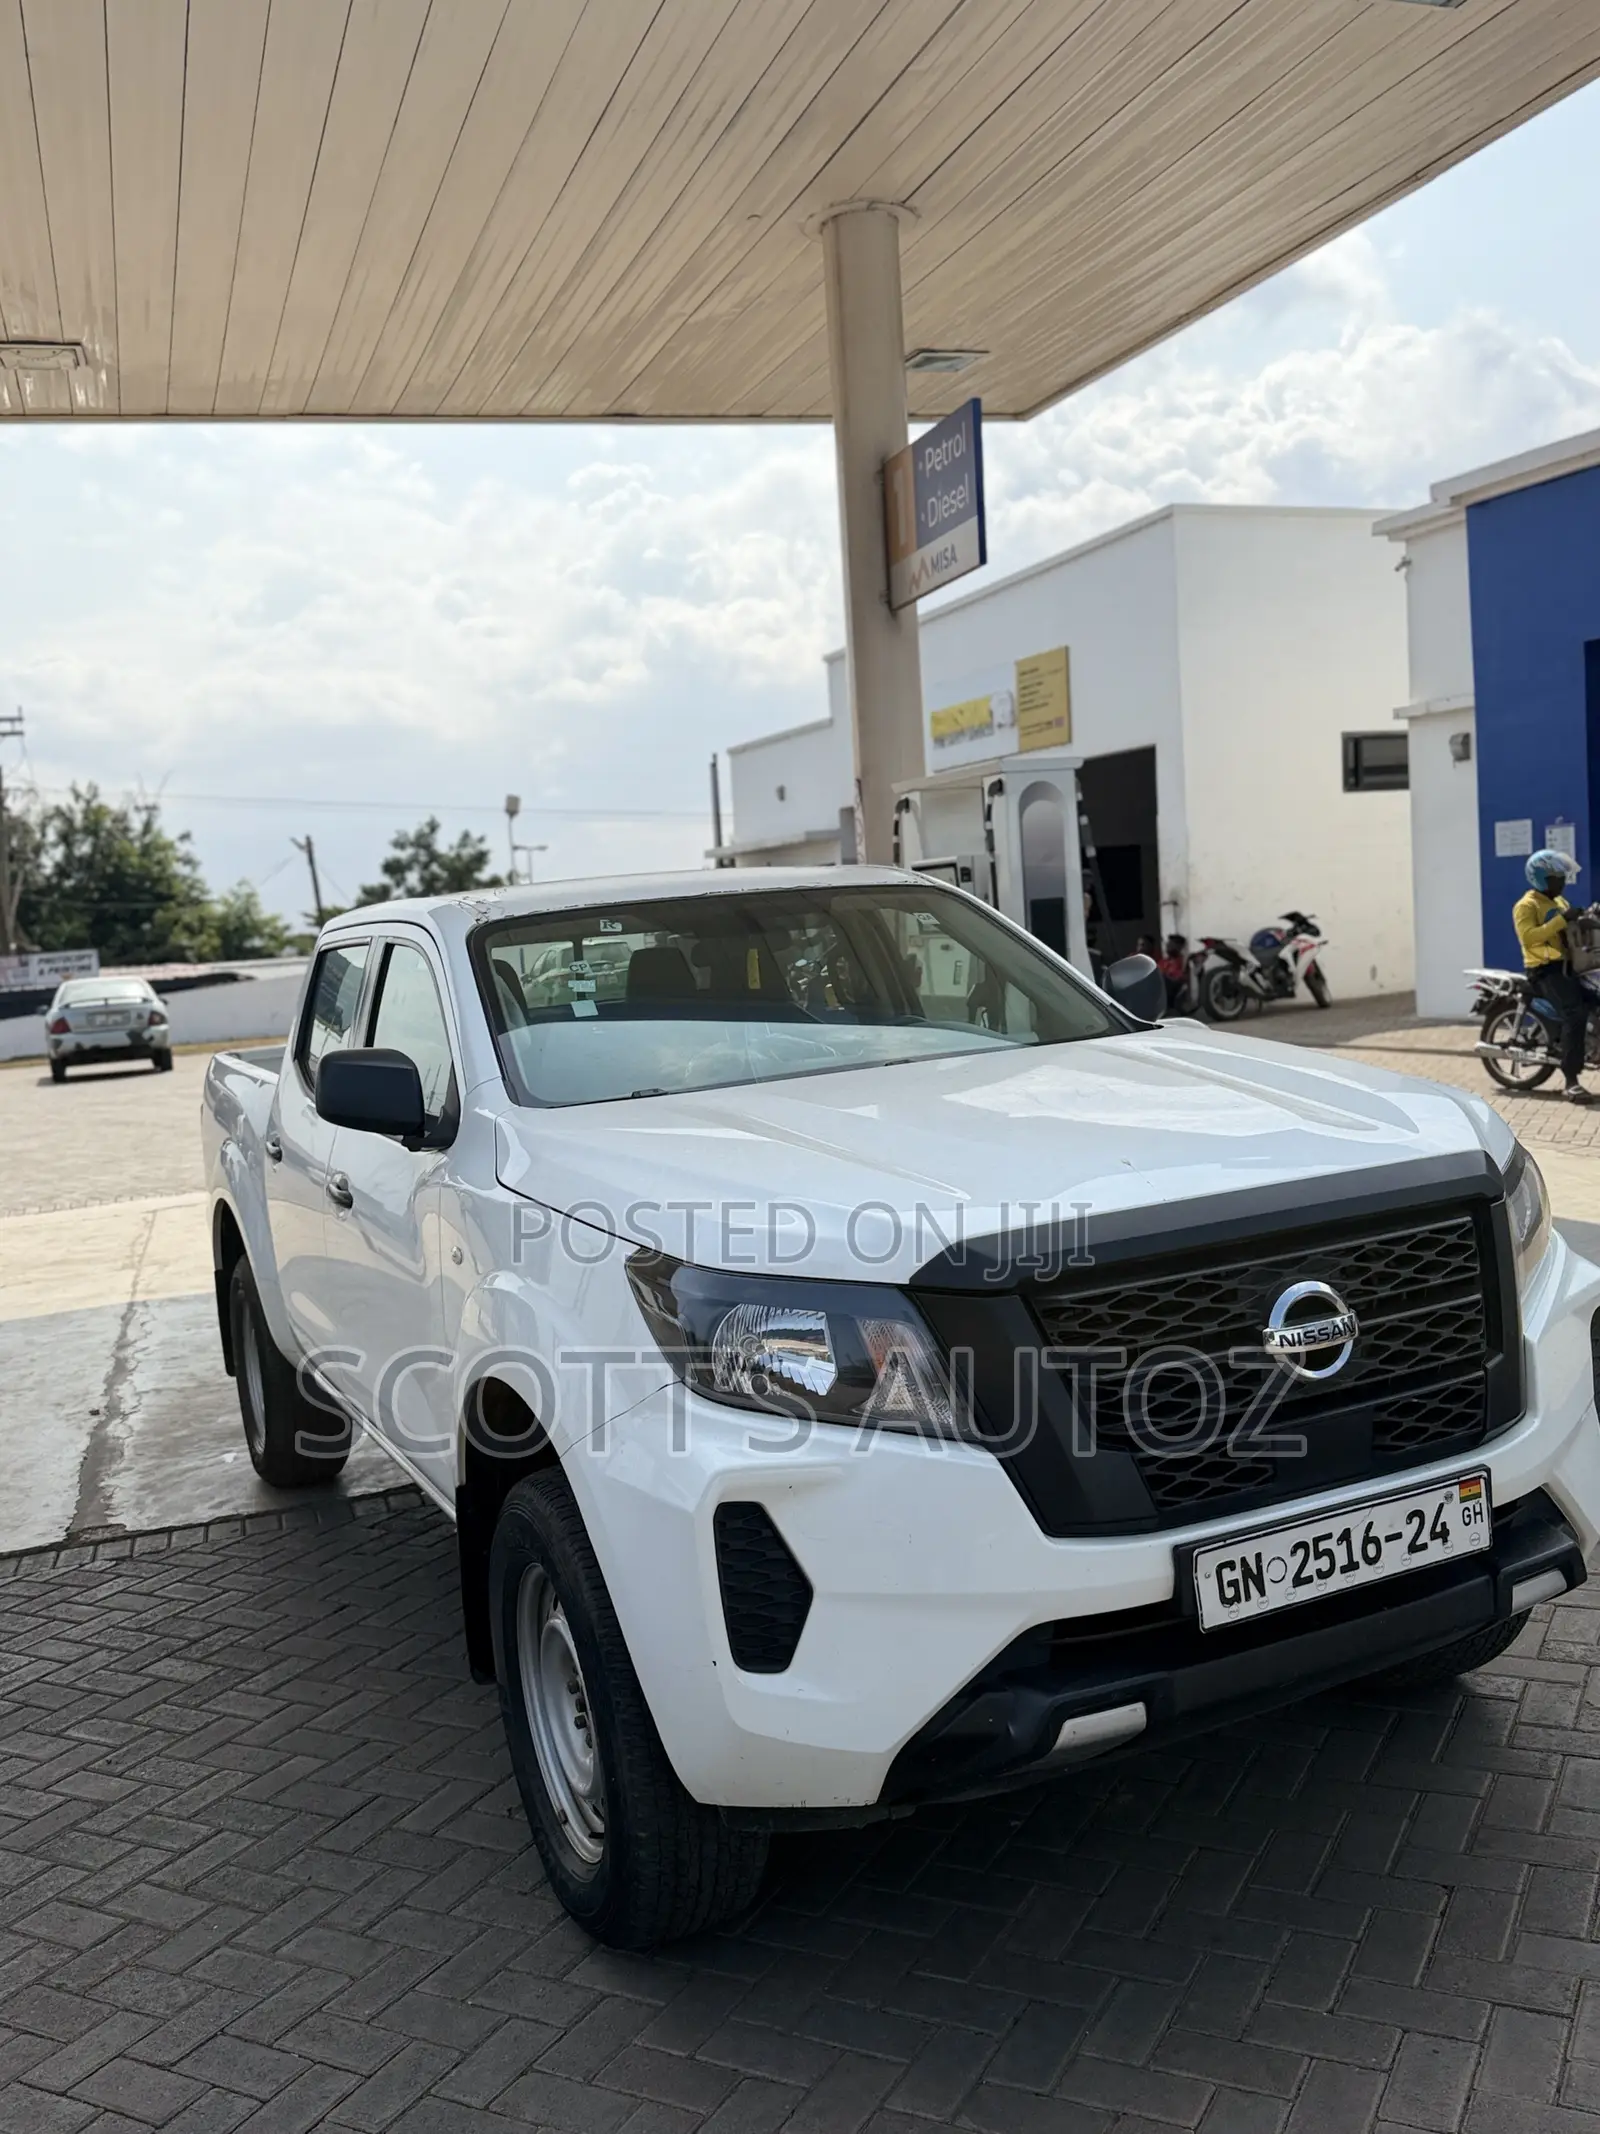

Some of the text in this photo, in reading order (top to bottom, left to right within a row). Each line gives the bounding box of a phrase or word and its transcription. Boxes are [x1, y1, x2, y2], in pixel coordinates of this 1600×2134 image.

[925, 422, 966, 478] Petrol
[927, 473, 969, 528] Diesel
[930, 544, 958, 575] MISA
[1279, 1315, 1355, 1348] NISSAN
[1462, 1503, 1484, 1527] GH
[1215, 1502, 1450, 1608] GN 2516-24
